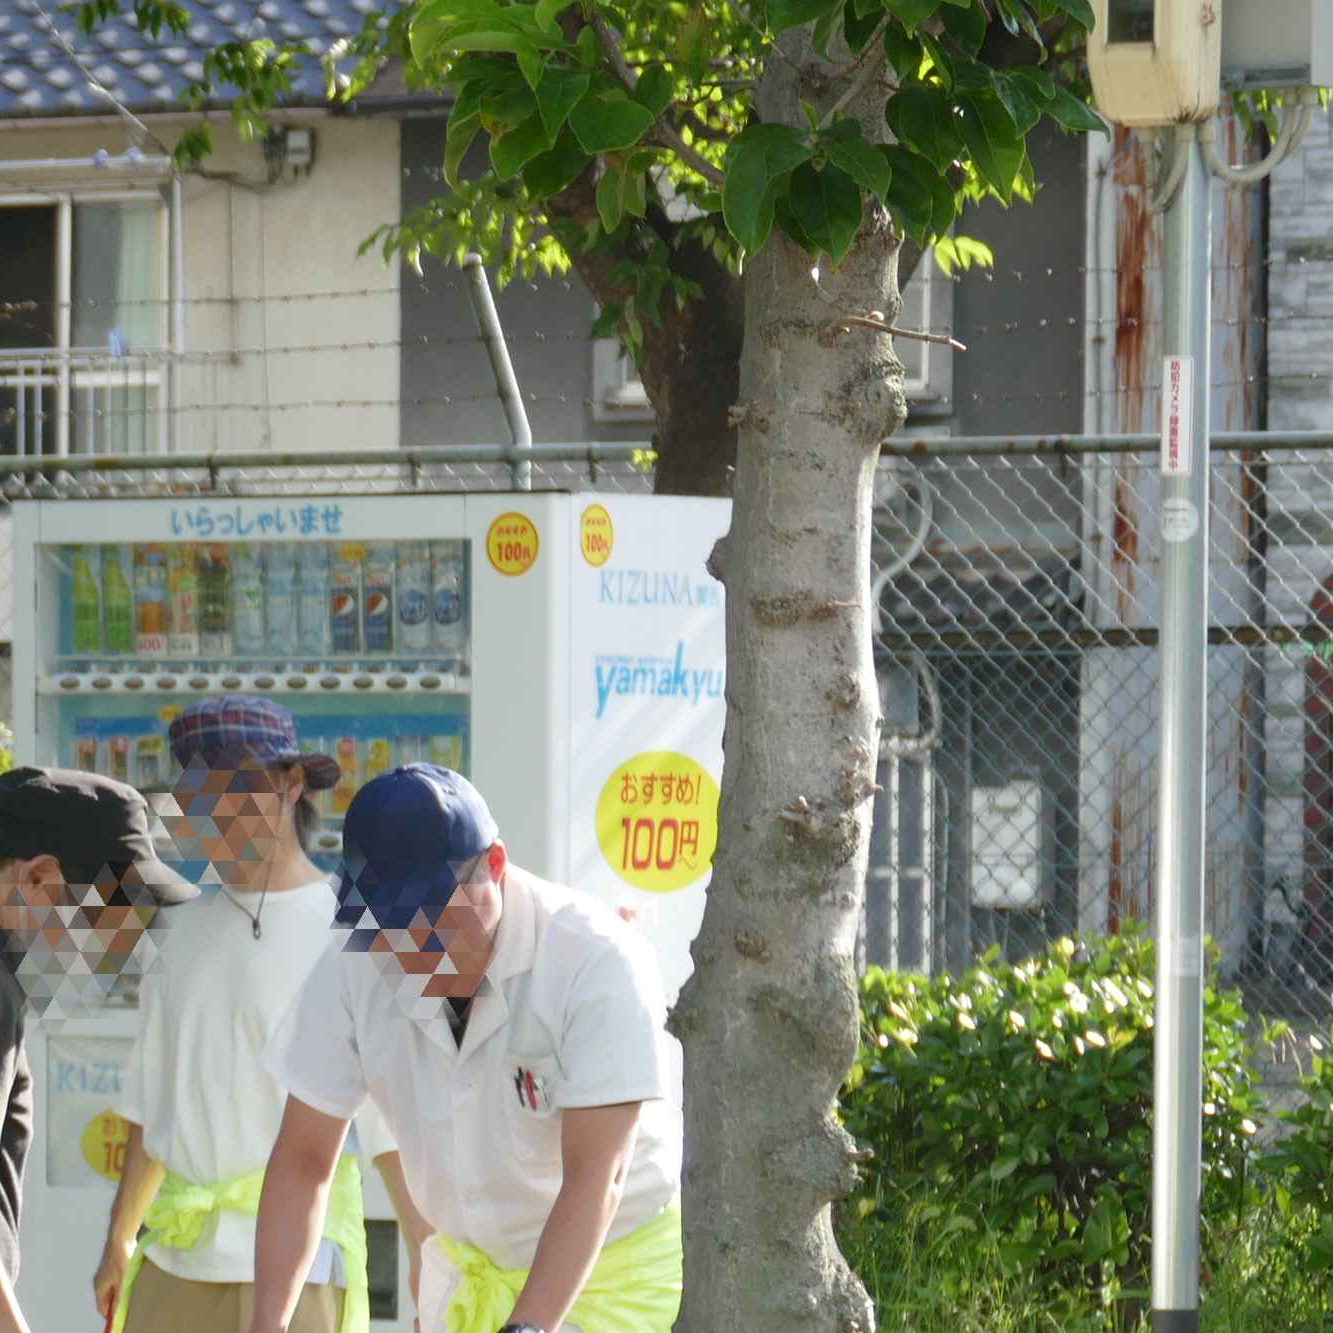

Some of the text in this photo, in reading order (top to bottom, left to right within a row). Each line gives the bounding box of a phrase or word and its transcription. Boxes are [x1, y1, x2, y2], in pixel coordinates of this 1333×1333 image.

[169, 503, 343, 536] いらっしゃいませ
[599, 569, 694, 605] KIZUNA
[595, 640, 725, 720] yamakyu
[620, 771, 702, 806] おすすめ!
